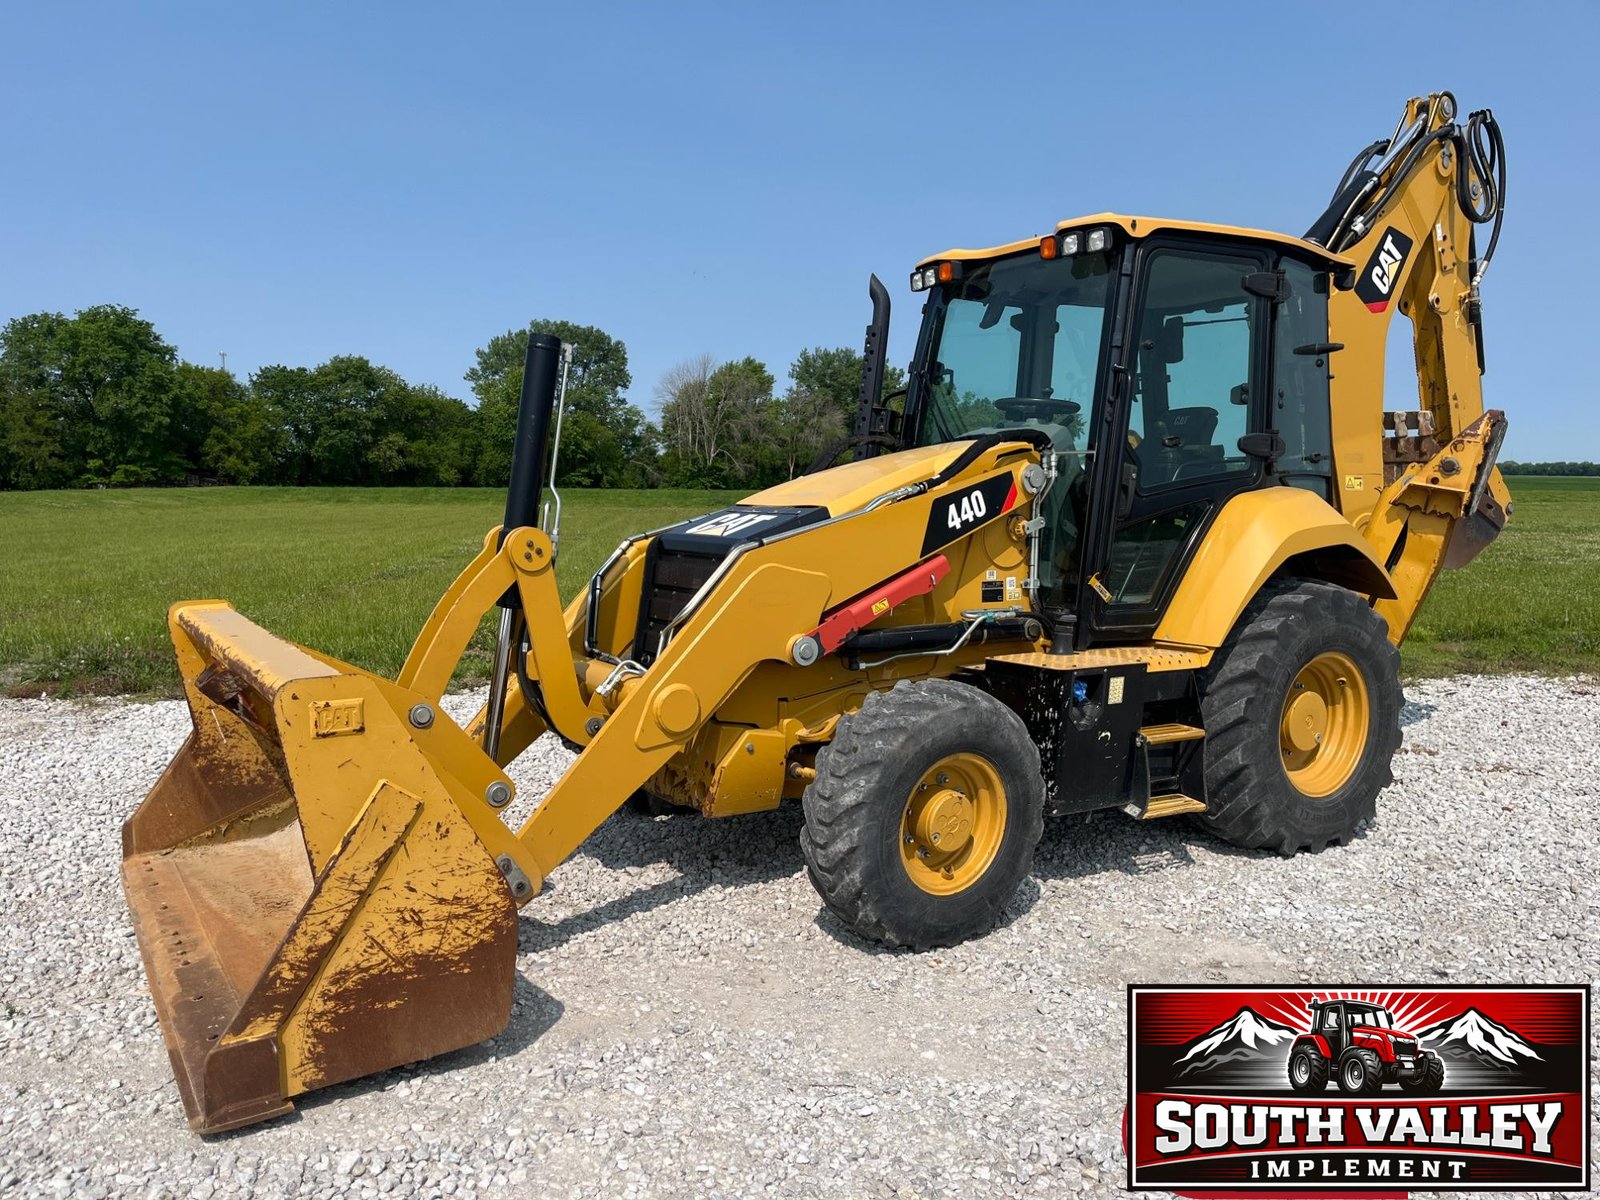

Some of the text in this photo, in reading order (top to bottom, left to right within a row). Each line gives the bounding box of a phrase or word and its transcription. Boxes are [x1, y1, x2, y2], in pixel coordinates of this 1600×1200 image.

[1371, 234, 1403, 295] CAT
[685, 513, 778, 537] CAT
[947, 489, 986, 530] 440
[318, 706, 358, 730] CAT
